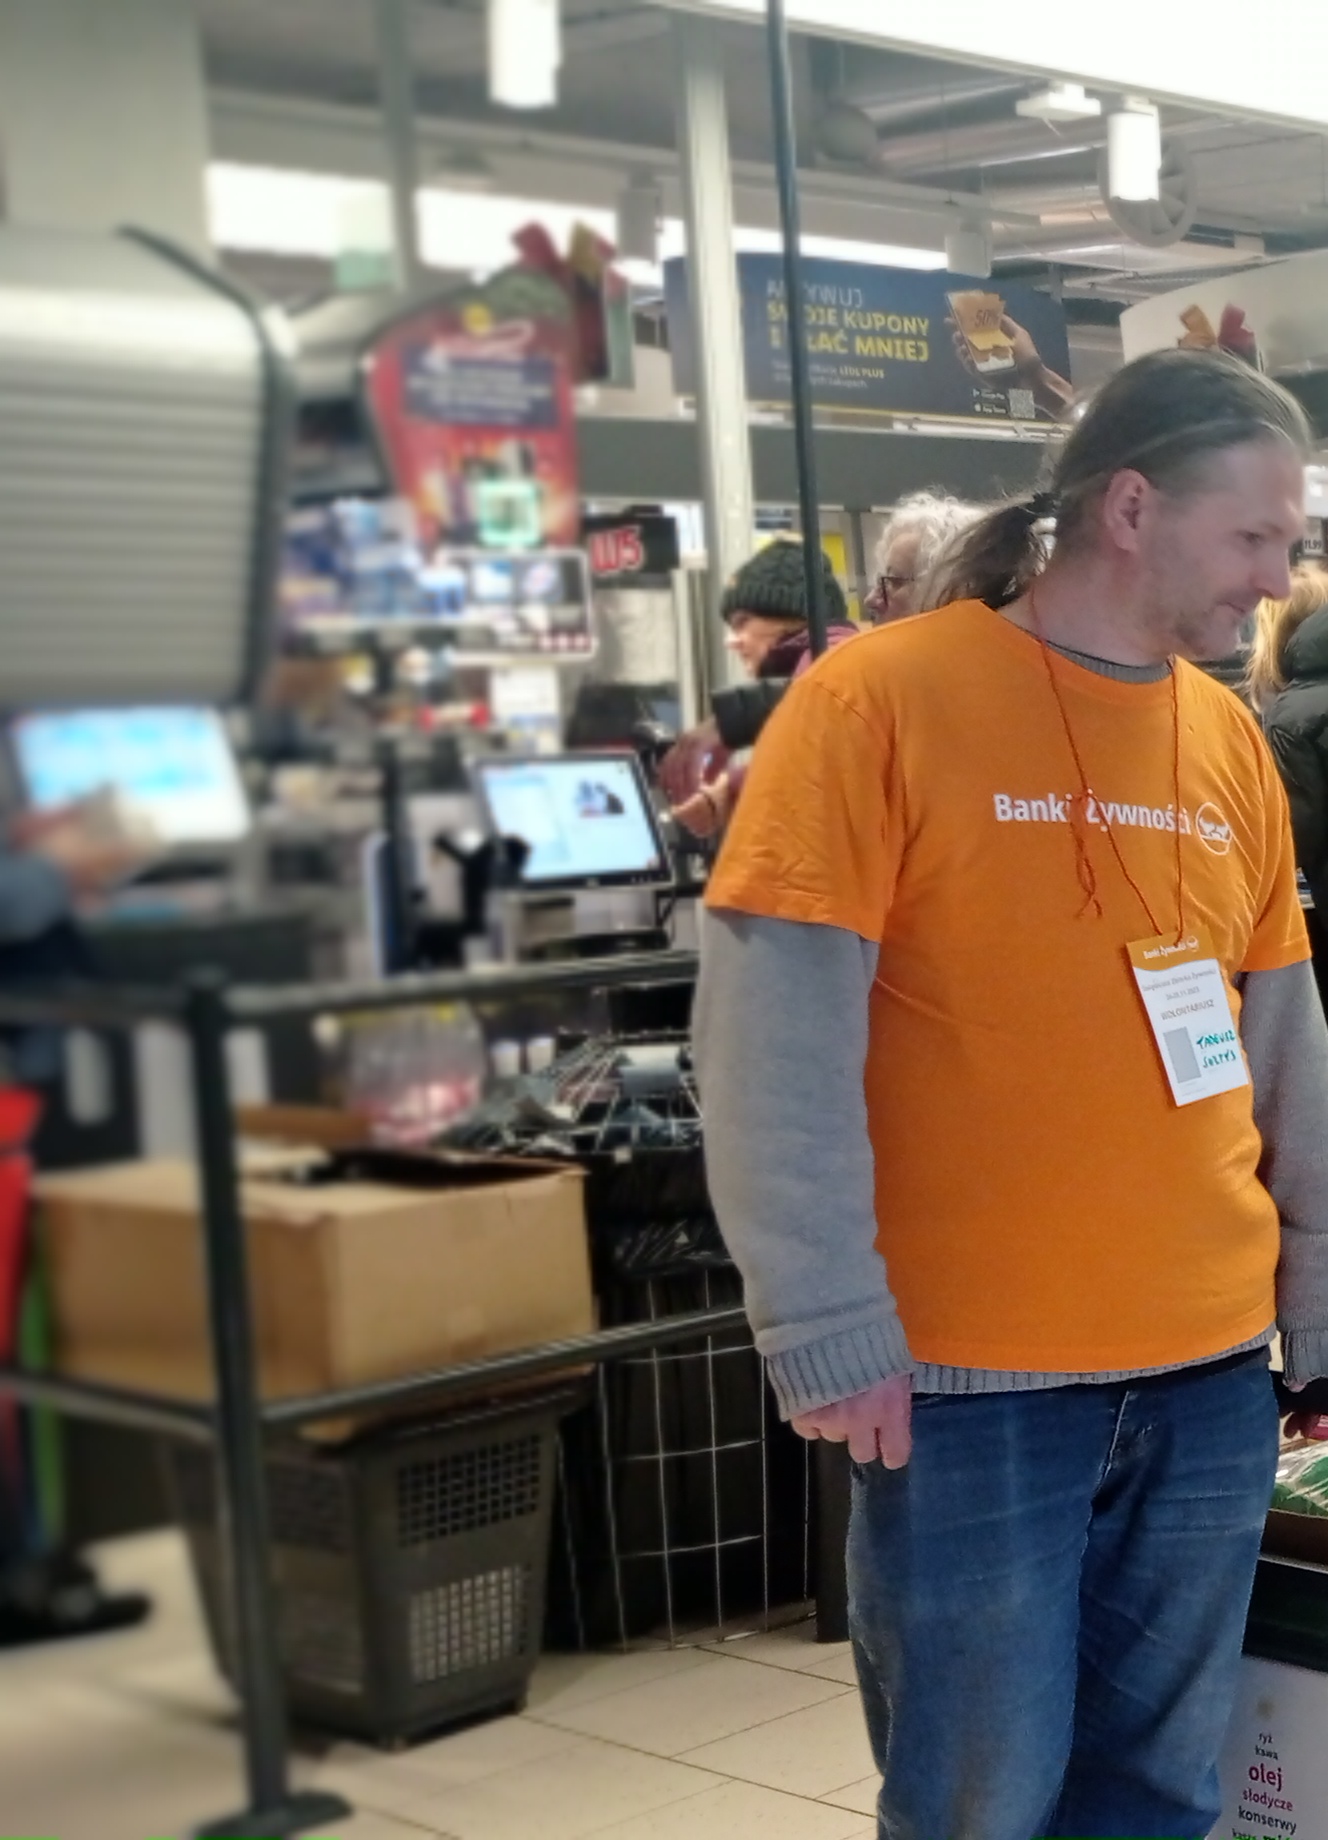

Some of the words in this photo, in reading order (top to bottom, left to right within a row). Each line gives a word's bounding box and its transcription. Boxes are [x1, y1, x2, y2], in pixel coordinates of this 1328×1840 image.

[844, 310, 930, 336] KUPONY
[804, 328, 849, 355] ŁAĆ
[854, 335, 930, 363] MNIEJ
[993, 793, 1072, 823] Banki
[1086, 788, 1192, 835] Żywności
[1258, 1732, 1273, 1745] ryż
[1255, 1745, 1279, 1760] kawa
[1248, 1763, 1283, 1792] olej
[1242, 1788, 1294, 1812] słodycze
[1238, 1805, 1297, 1836] konserwy
